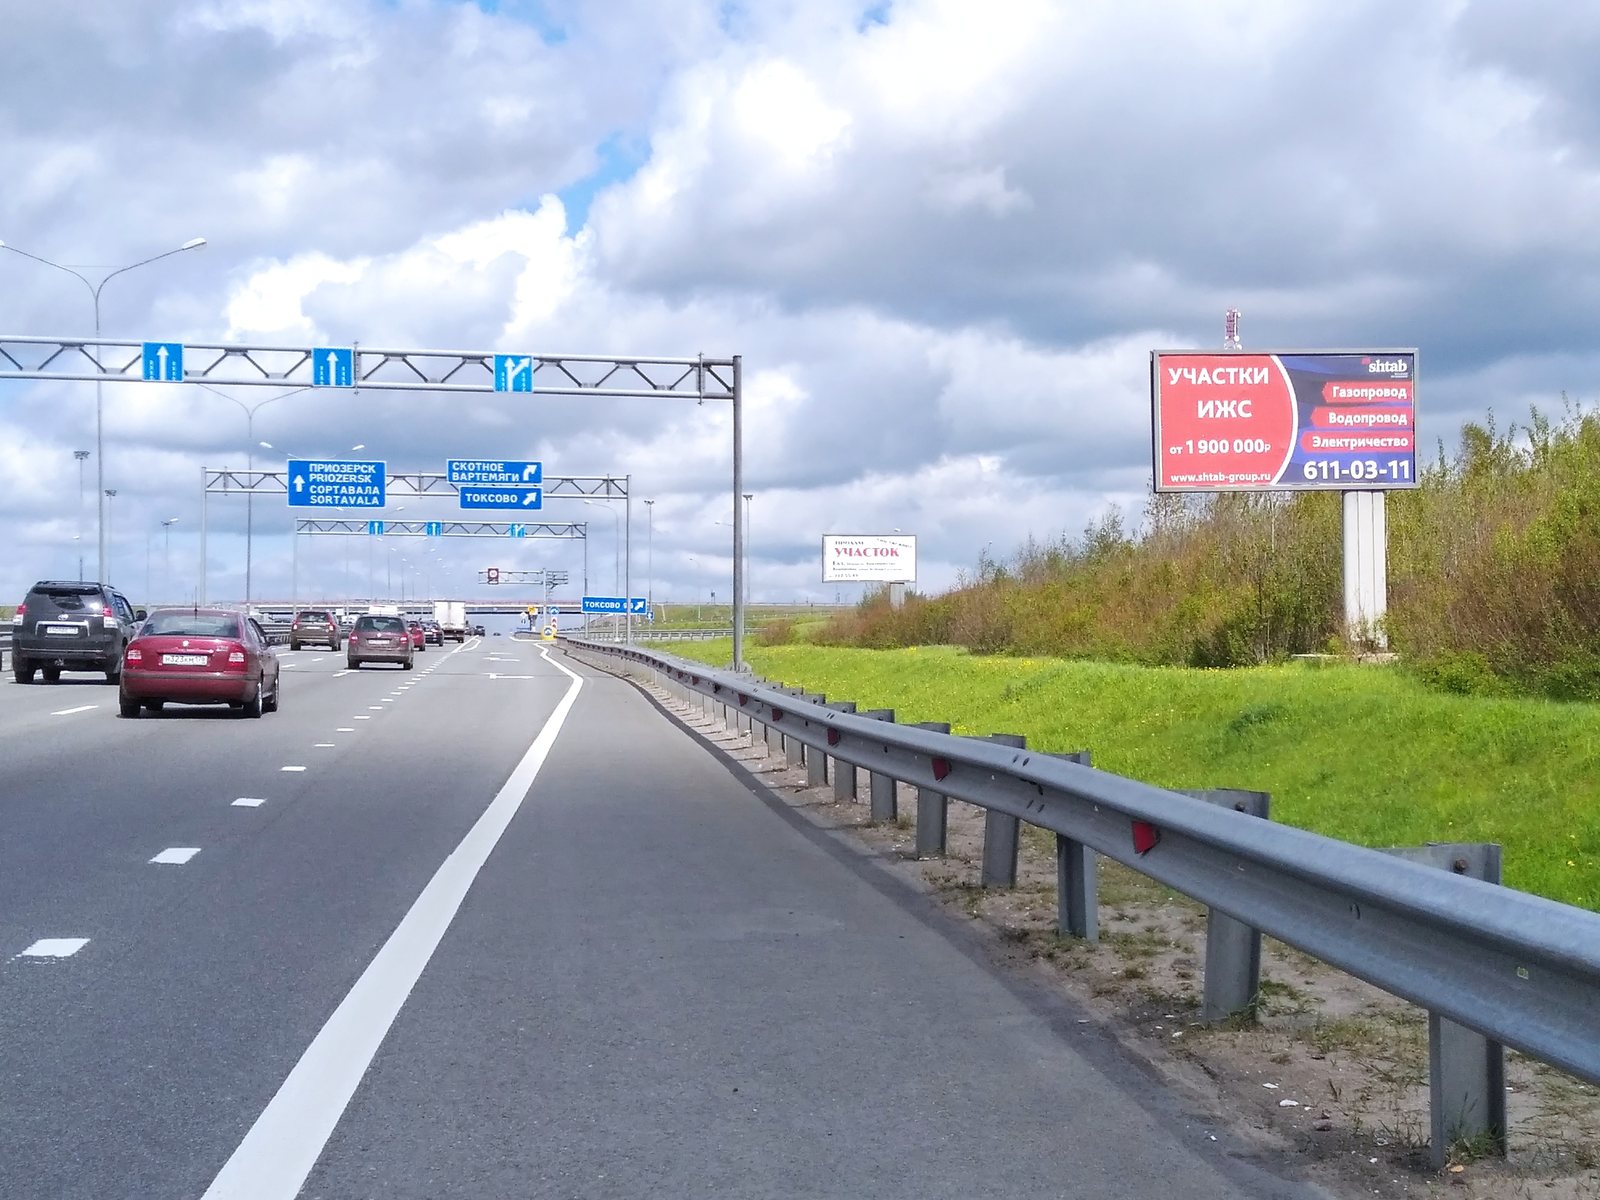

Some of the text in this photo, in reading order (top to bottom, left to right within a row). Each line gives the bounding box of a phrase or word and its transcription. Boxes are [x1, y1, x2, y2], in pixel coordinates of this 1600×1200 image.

[1368, 359, 1407, 373] shtab
[1168, 367, 1269, 385] УЧАСТКИ
[1332, 386, 1407, 400] Газопровод
[1197, 400, 1252, 418] ИЖС
[1328, 412, 1407, 427] Водопровод
[1169, 446, 1183, 454] от
[1197, 439, 1230, 454] 900
[1312, 436, 1409, 450] Электричество
[309, 463, 376, 474] ПРИОЗЕРСК
[452, 462, 505, 472] СКОТНОЕ
[1303, 460, 1410, 479] 611-03-11
[309, 473, 372, 483] PRIOZERSK
[452, 472, 520, 482] ВАРТЕМЯГИ
[1170, 472, 1271, 483] www.shtab-group.ru
[309, 485, 380, 495] СОРТАВАЛА
[310, 495, 380, 505] SORTAVALA
[465, 493, 518, 503] ТОКСОВО
[834, 547, 899, 557] УЧАСТОК
[584, 601, 620, 609] ТОКСОВО
